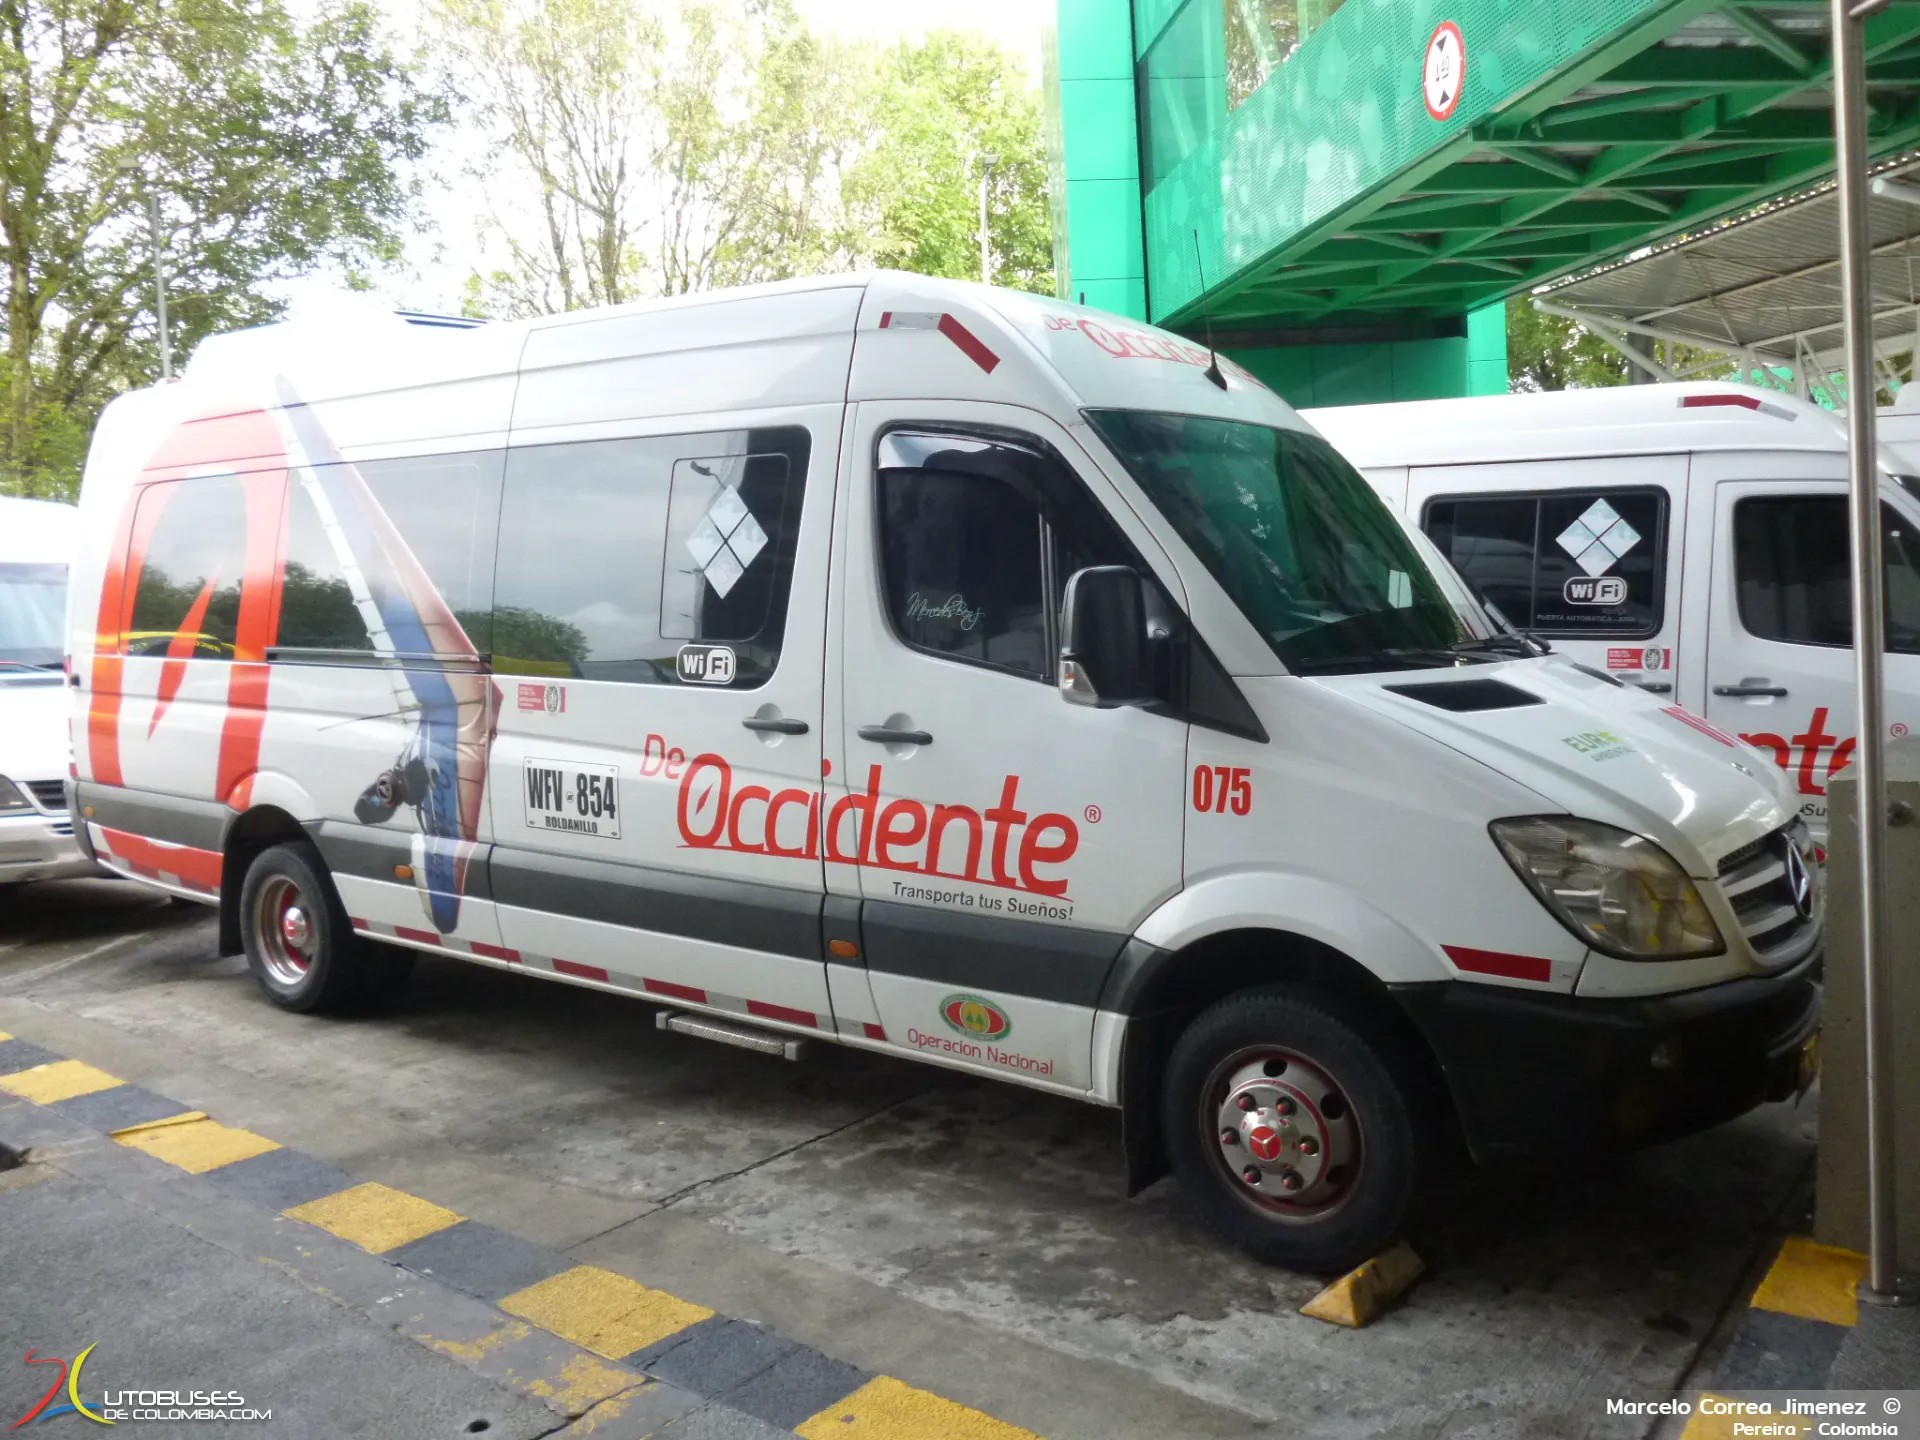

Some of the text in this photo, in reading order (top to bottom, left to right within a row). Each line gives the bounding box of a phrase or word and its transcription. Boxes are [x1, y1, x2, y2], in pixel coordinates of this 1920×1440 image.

[1571, 584, 1619, 598] WiFi
[683, 654, 729, 675] WiFi
[527, 767, 616, 819] WFV 854
[1193, 764, 1251, 817] 075
[640, 734, 685, 779] De
[676, 753, 1079, 902] Occidente
[892, 881, 1074, 920] Transporta tus Sueños!
[907, 1028, 1053, 1075] Operacion Nacional
